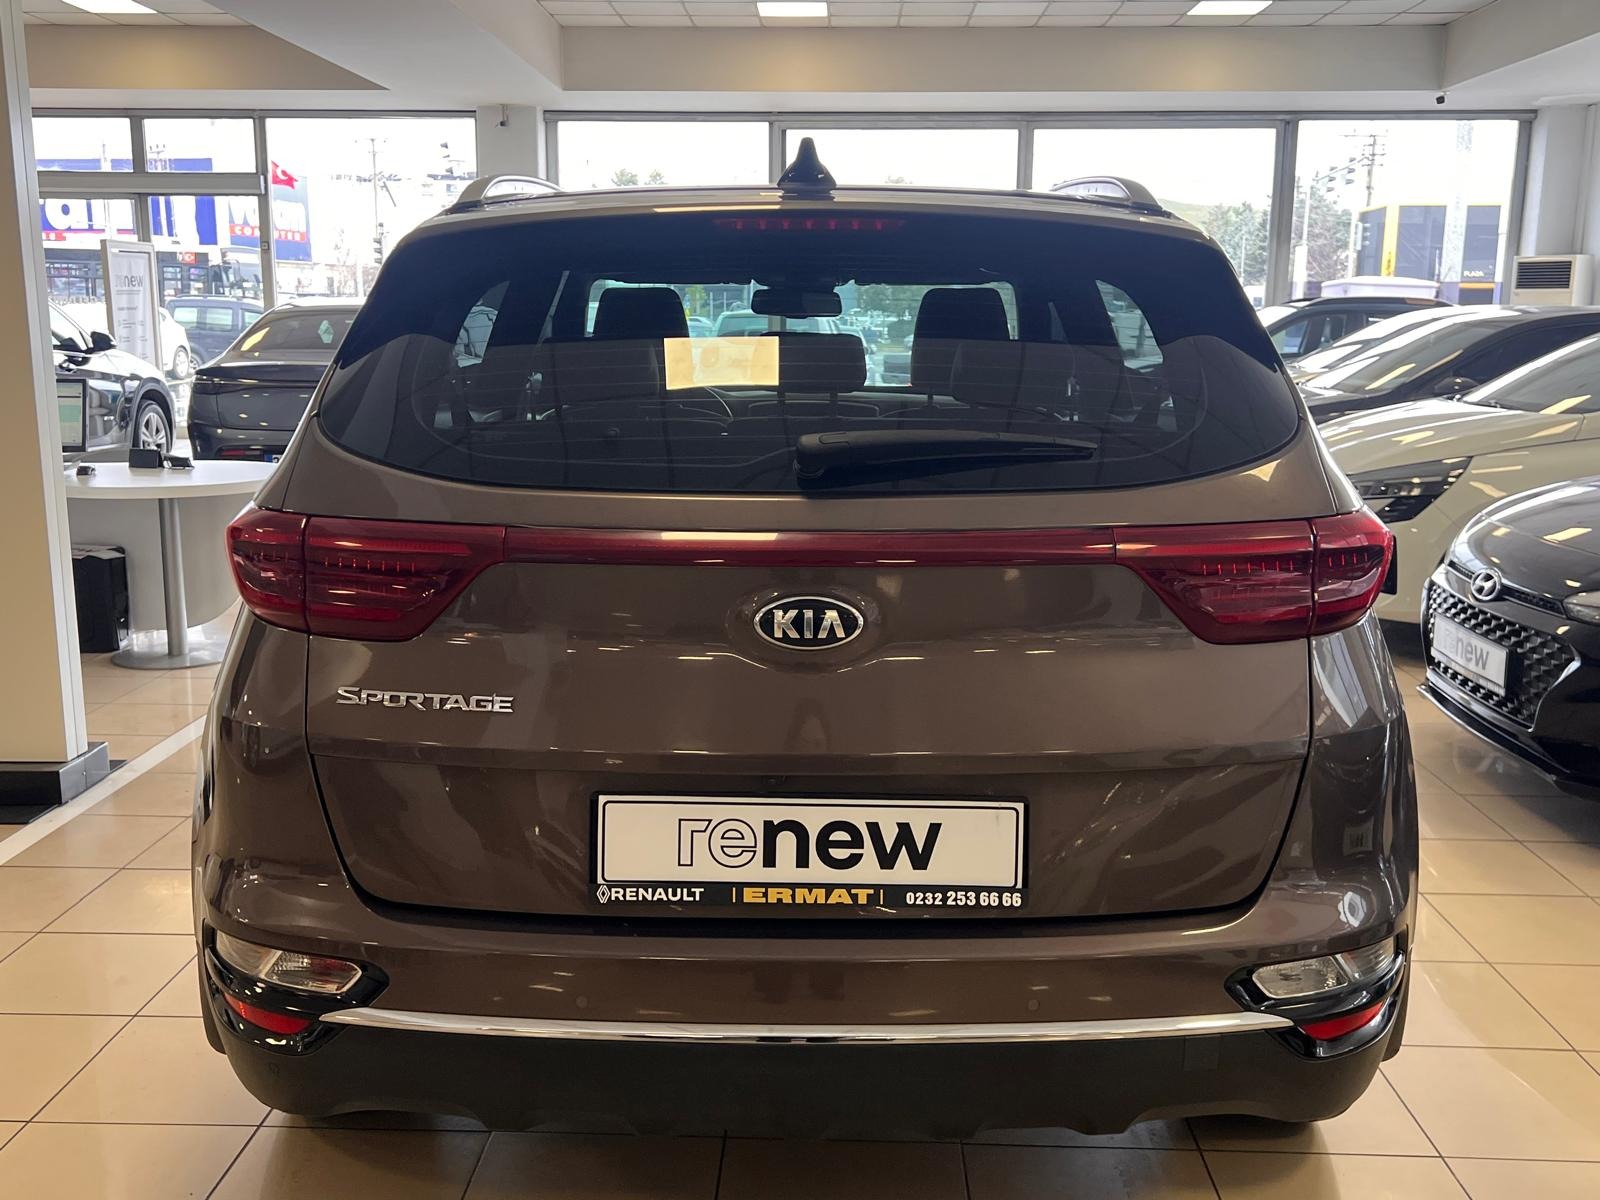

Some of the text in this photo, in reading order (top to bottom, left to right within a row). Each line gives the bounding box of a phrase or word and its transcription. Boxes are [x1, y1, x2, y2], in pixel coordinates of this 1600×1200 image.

[772, 609, 846, 638] KIA
[336, 686, 514, 713] SPORTAGE
[677, 817, 942, 871] renew
[611, 887, 1022, 907] RENAULT ERMAT 0232 253 66 66
